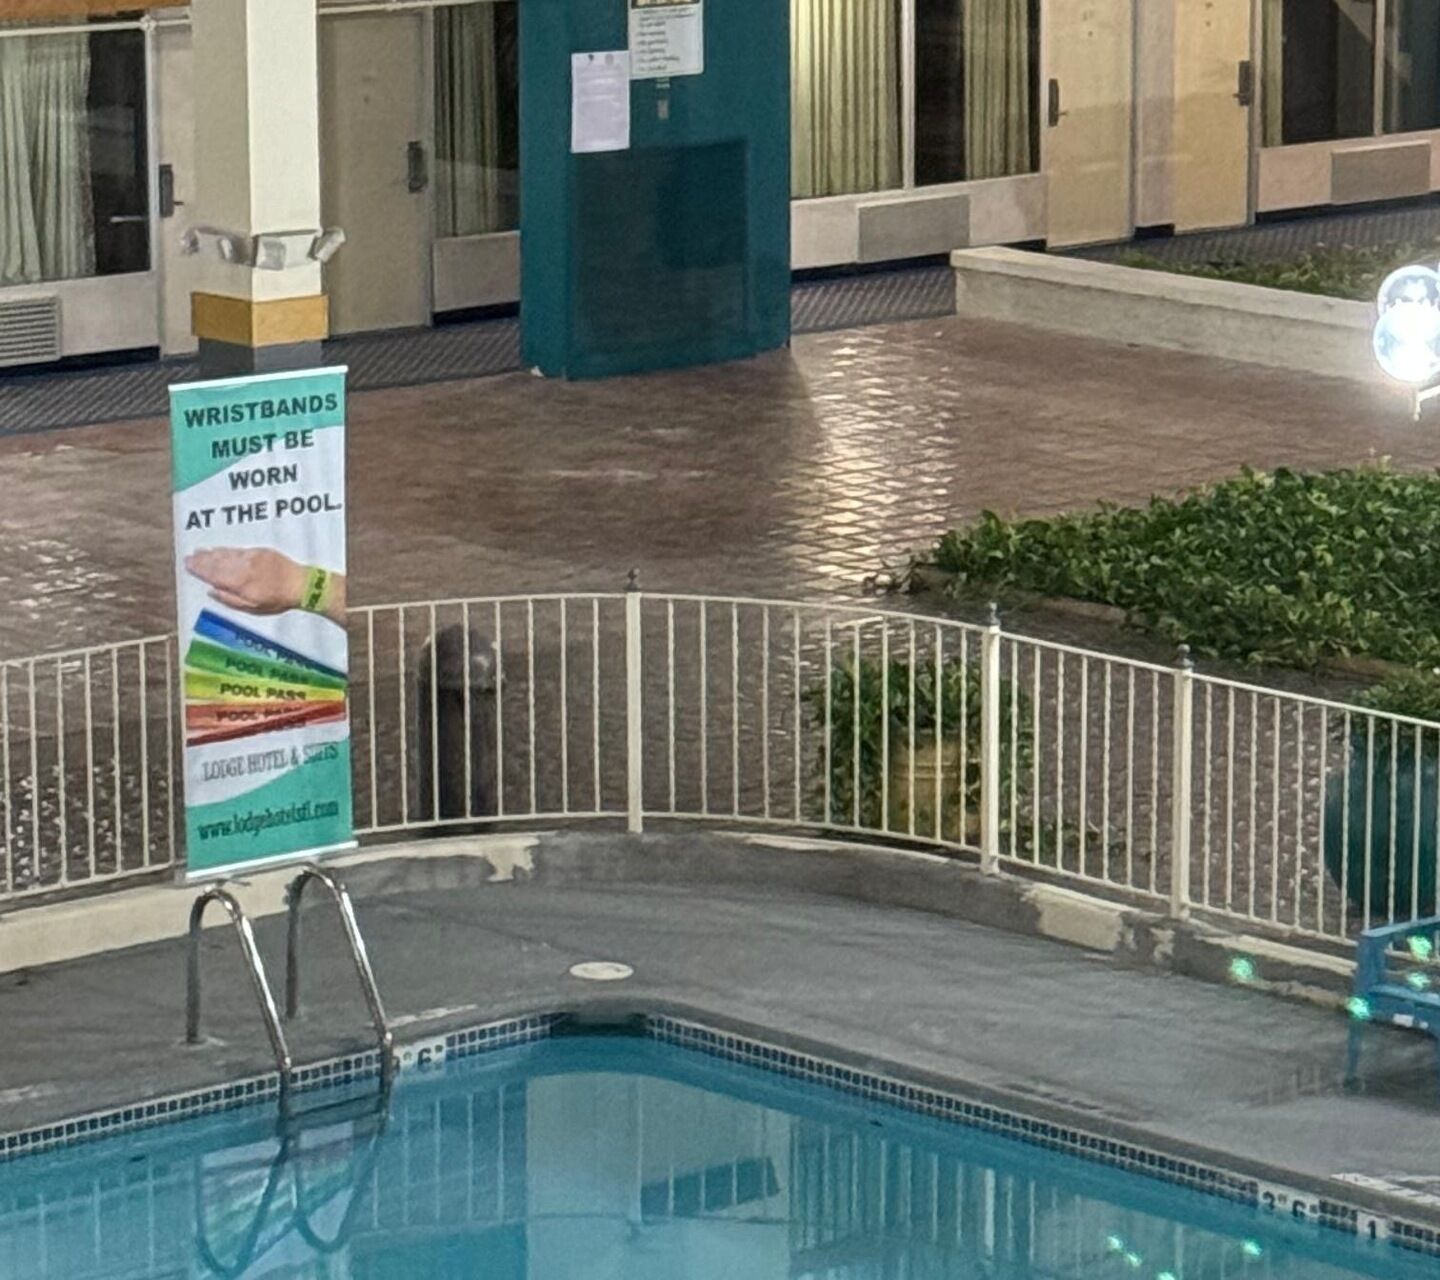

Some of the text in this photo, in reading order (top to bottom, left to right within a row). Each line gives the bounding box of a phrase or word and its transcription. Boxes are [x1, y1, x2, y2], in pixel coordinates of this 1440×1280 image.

[183, 393, 338, 429] WRISTBANDS
[211, 429, 315, 459] MUST BE
[228, 464, 298, 491] WORN
[185, 493, 343, 531] AT THE POOL.
[219, 682, 307, 700] POOL PASS
[201, 755, 245, 782] LODGE
[248, 748, 290, 776] HOTEL
